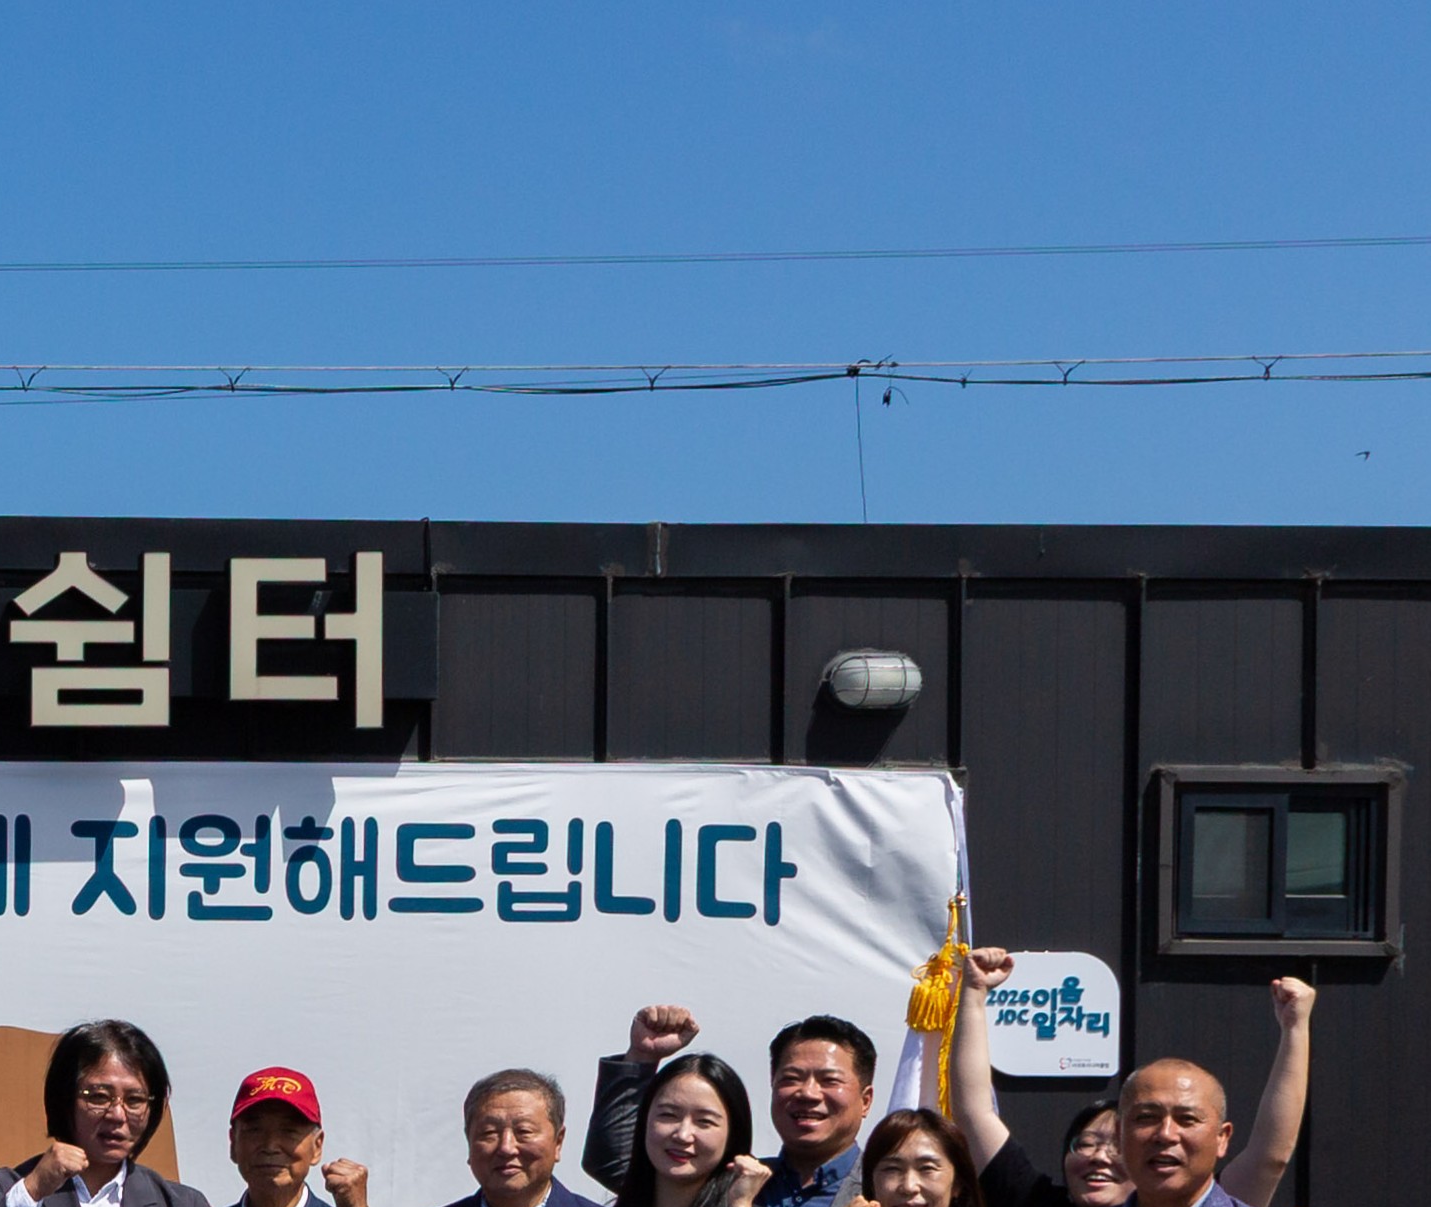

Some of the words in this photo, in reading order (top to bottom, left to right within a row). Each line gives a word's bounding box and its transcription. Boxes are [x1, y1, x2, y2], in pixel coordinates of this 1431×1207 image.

[70, 812, 798, 927] 지원해드립니다
[986, 989, 1031, 1006] 2026
[1032, 976, 1084, 1012] 이음
[995, 1009, 1030, 1026] JDC
[1032, 1006, 1110, 1041] 일자리
